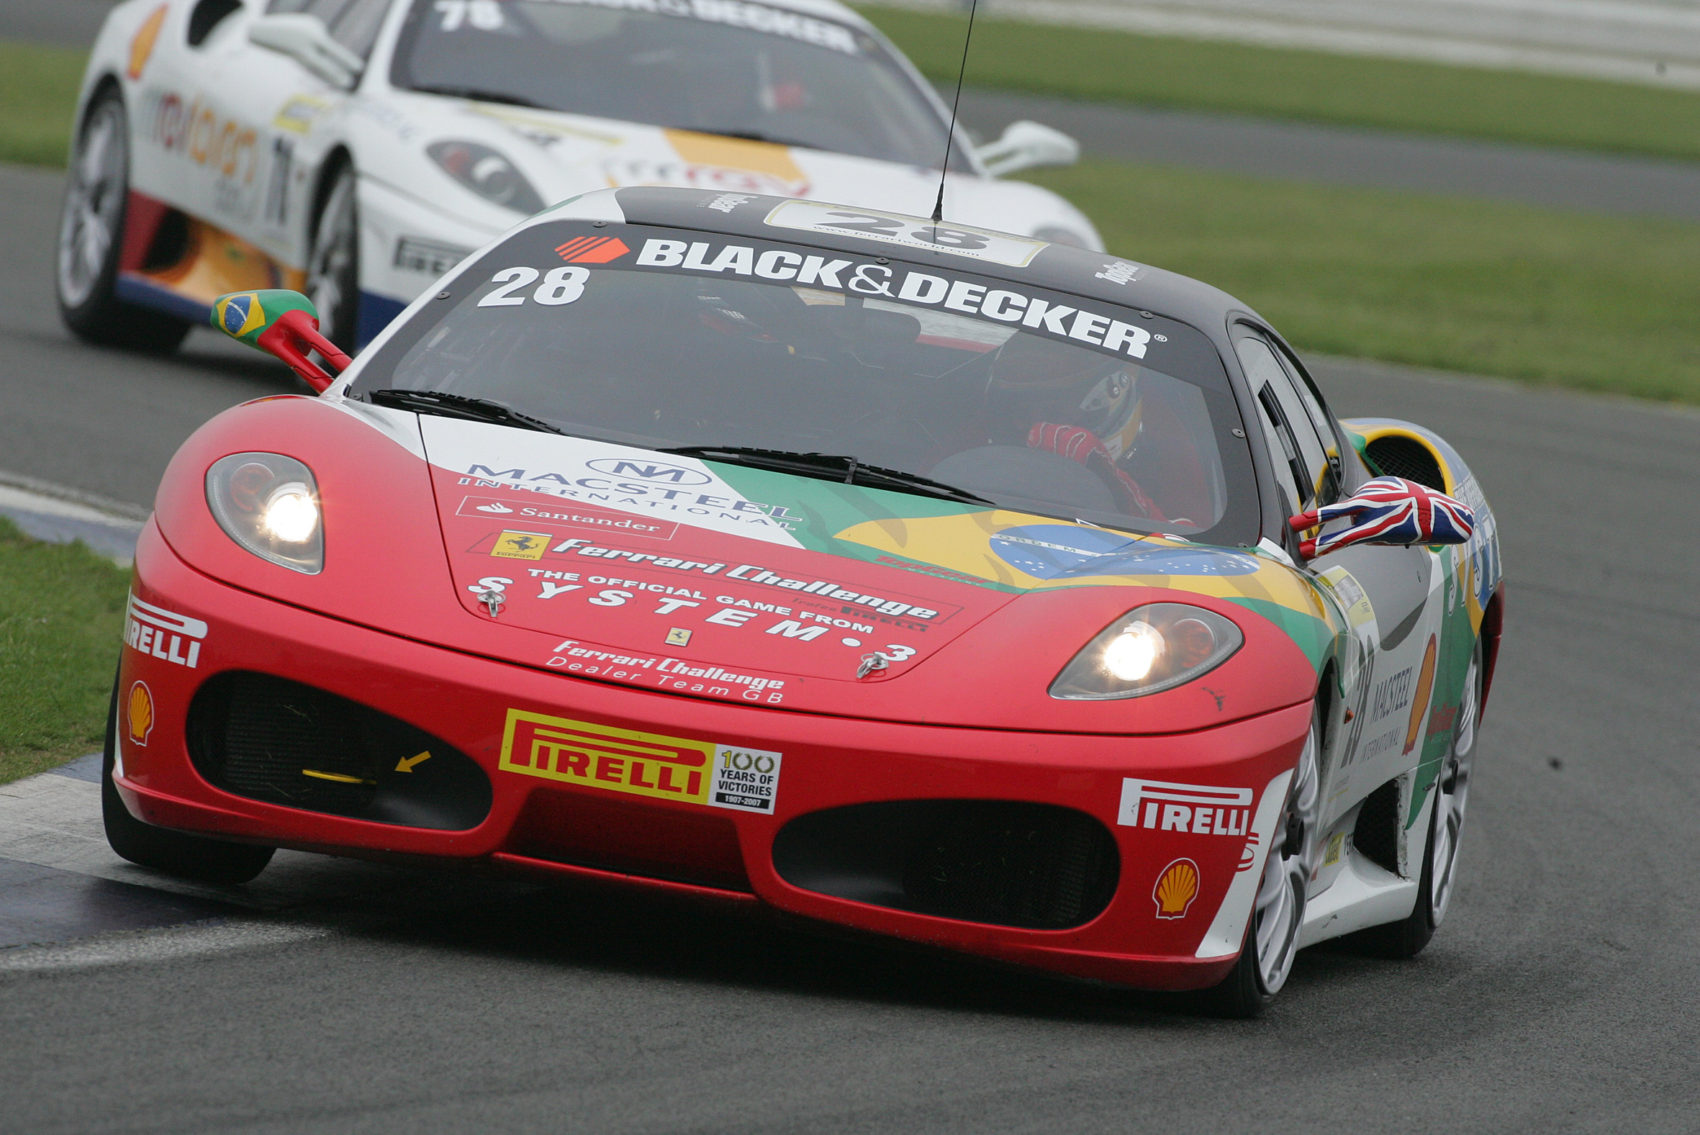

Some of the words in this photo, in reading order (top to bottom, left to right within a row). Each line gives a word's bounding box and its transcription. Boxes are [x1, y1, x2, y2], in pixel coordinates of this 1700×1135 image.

[816, 211, 991, 251] 28
[477, 265, 590, 308] 28
[456, 476, 797, 531] INTERNATIONAL
[466, 463, 803, 522] MACSTEEL
[519, 507, 661, 532] Santander
[552, 538, 728, 576] Ferrari
[725, 564, 940, 620] Challenge
[527, 568, 581, 582] THE
[587, 576, 708, 601] OFFICIAL
[714, 595, 792, 616] GAME
[799, 610, 874, 634] FROM
[546, 656, 642, 681] Dealer
[658, 675, 730, 696] Team
[552, 640, 657, 669] Ferrari
[655, 658, 785, 691] Challenge
[509, 718, 707, 796] PIRELLI
[720, 769, 756, 783] YEARS
[760, 774, 774, 785] OF
[721, 750, 775, 774] 100
[718, 780, 772, 797] VICTORIES
[725, 795, 761, 807] 1907-2007
[1116, 777, 1254, 836] PIRELLI
